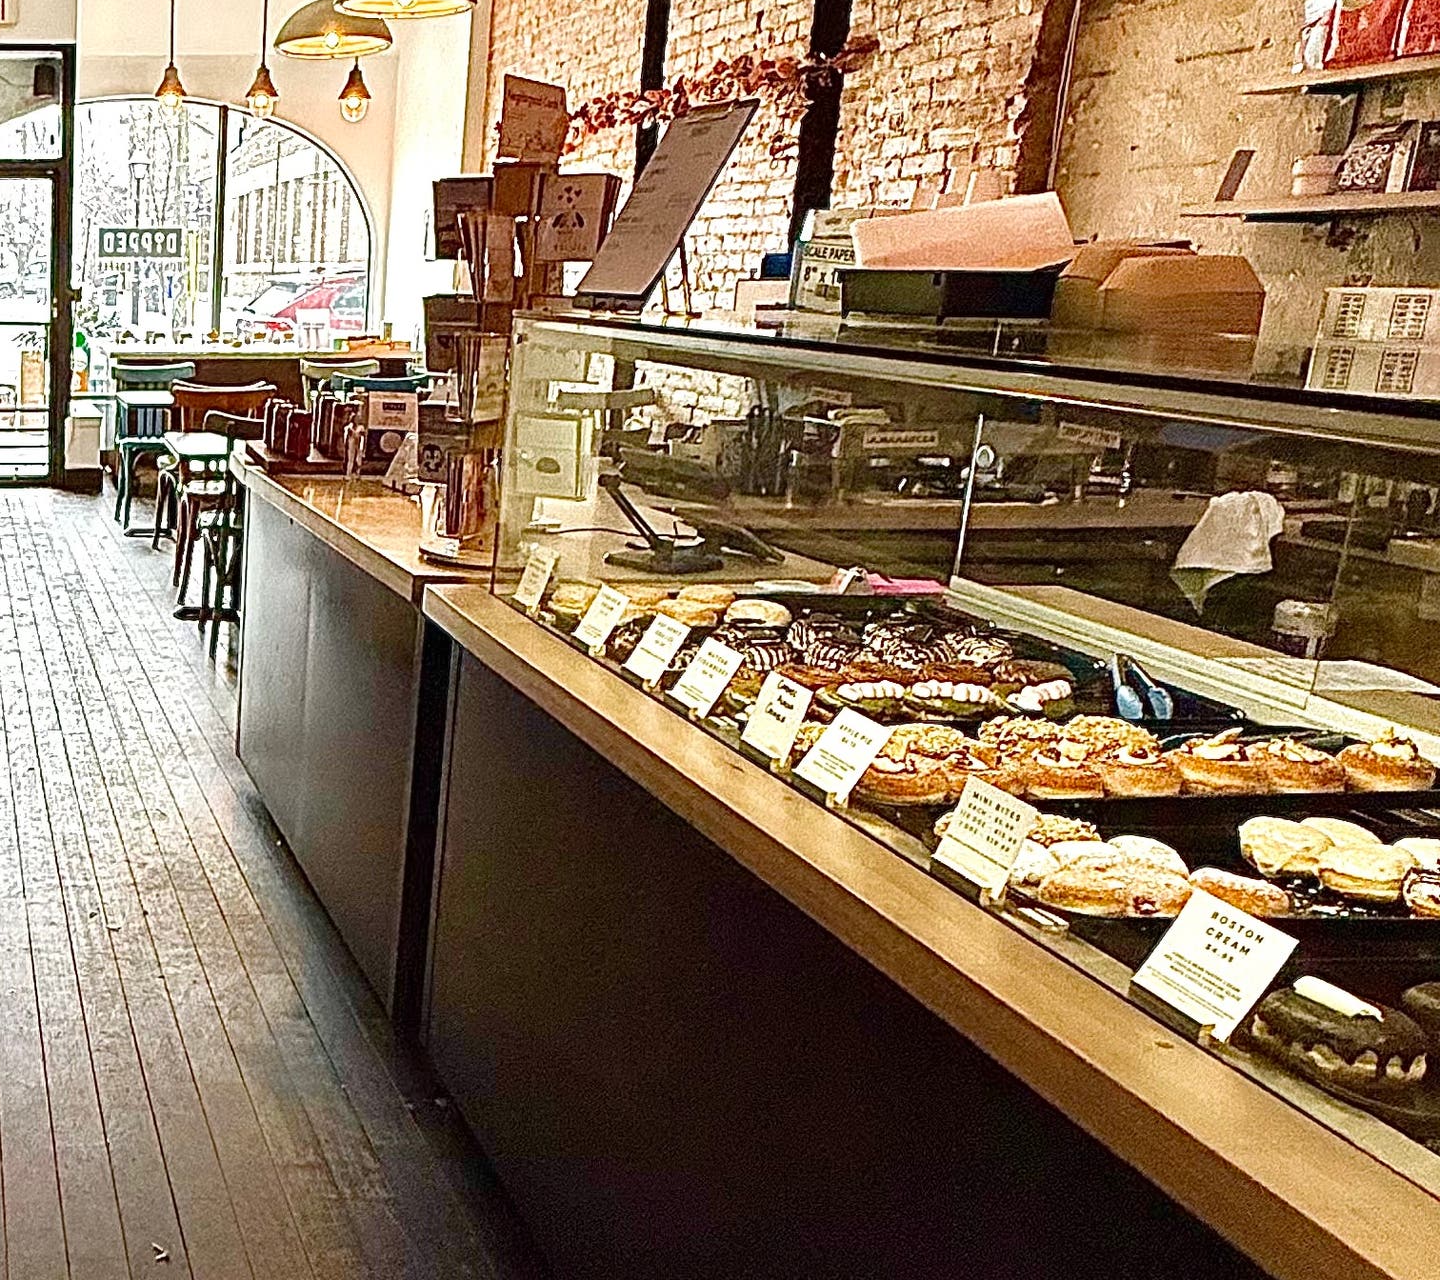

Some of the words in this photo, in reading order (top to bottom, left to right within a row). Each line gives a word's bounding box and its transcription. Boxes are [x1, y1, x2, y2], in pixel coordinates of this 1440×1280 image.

[828, 247, 856, 262] PAPER
[971, 791, 993, 806] MINI
[994, 803, 1021, 822] BITES
[1205, 927, 1251, 956] CREAM
[1210, 911, 1265, 944] BOSTON
